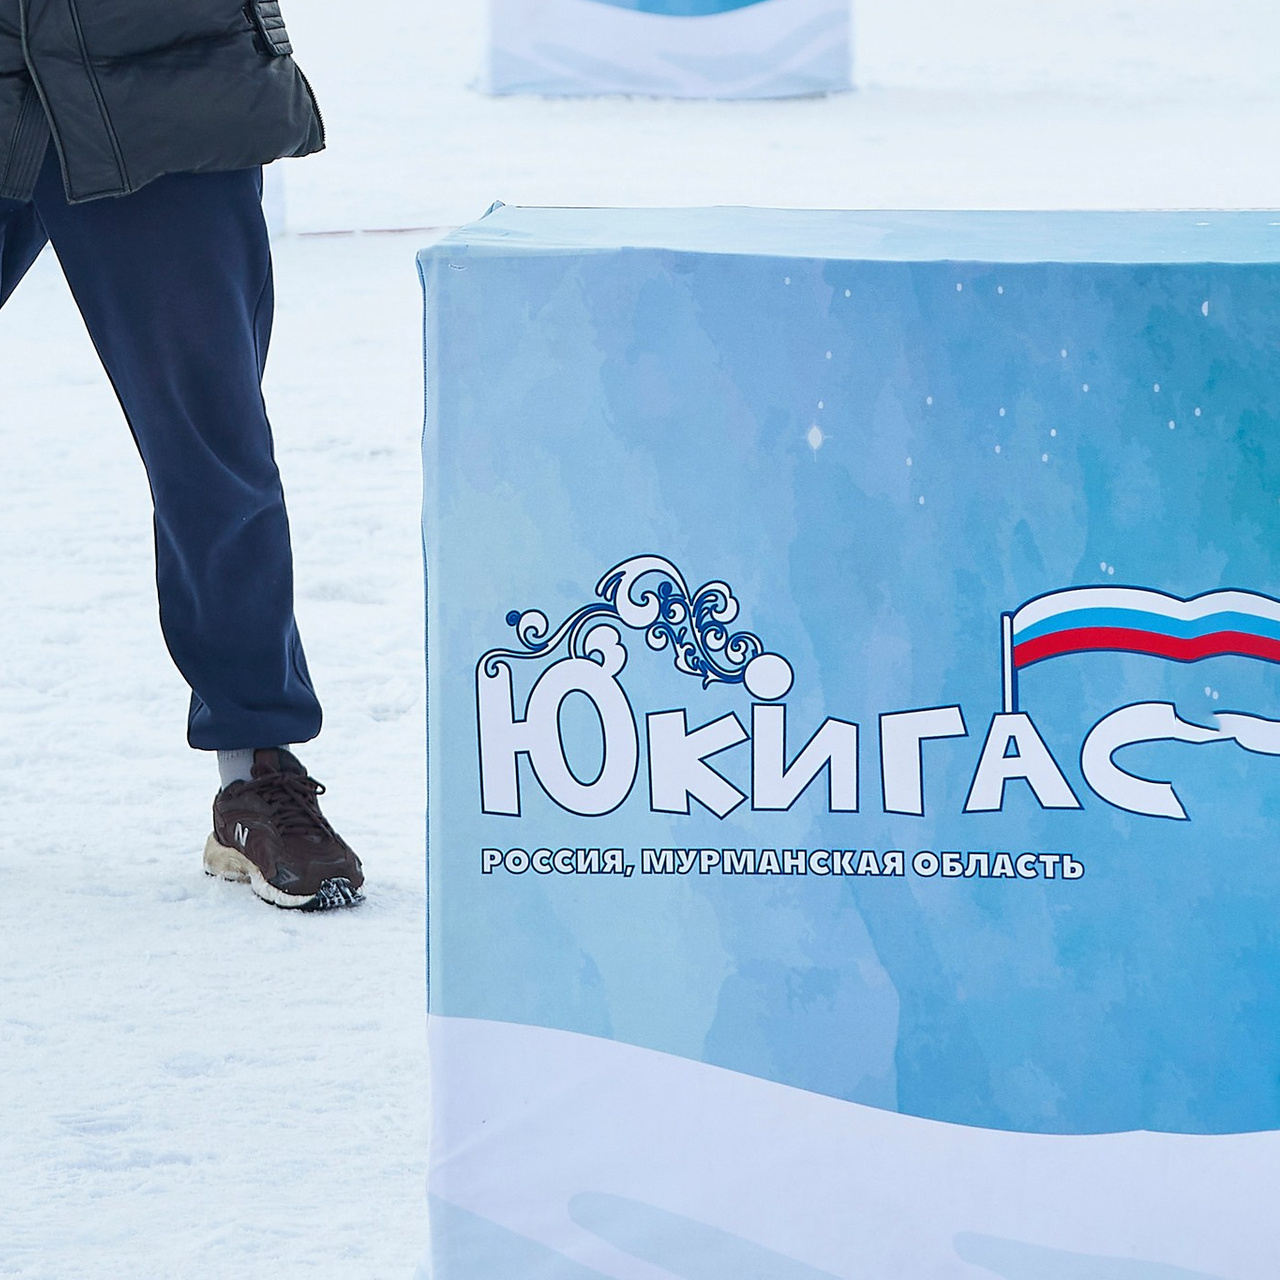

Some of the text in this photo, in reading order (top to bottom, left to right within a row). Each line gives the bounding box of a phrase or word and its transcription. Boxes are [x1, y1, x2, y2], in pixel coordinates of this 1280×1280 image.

[481, 847, 1085, 880] РОССИЯ, МУРМАНСКАЯ ОБЛАСТЬ
